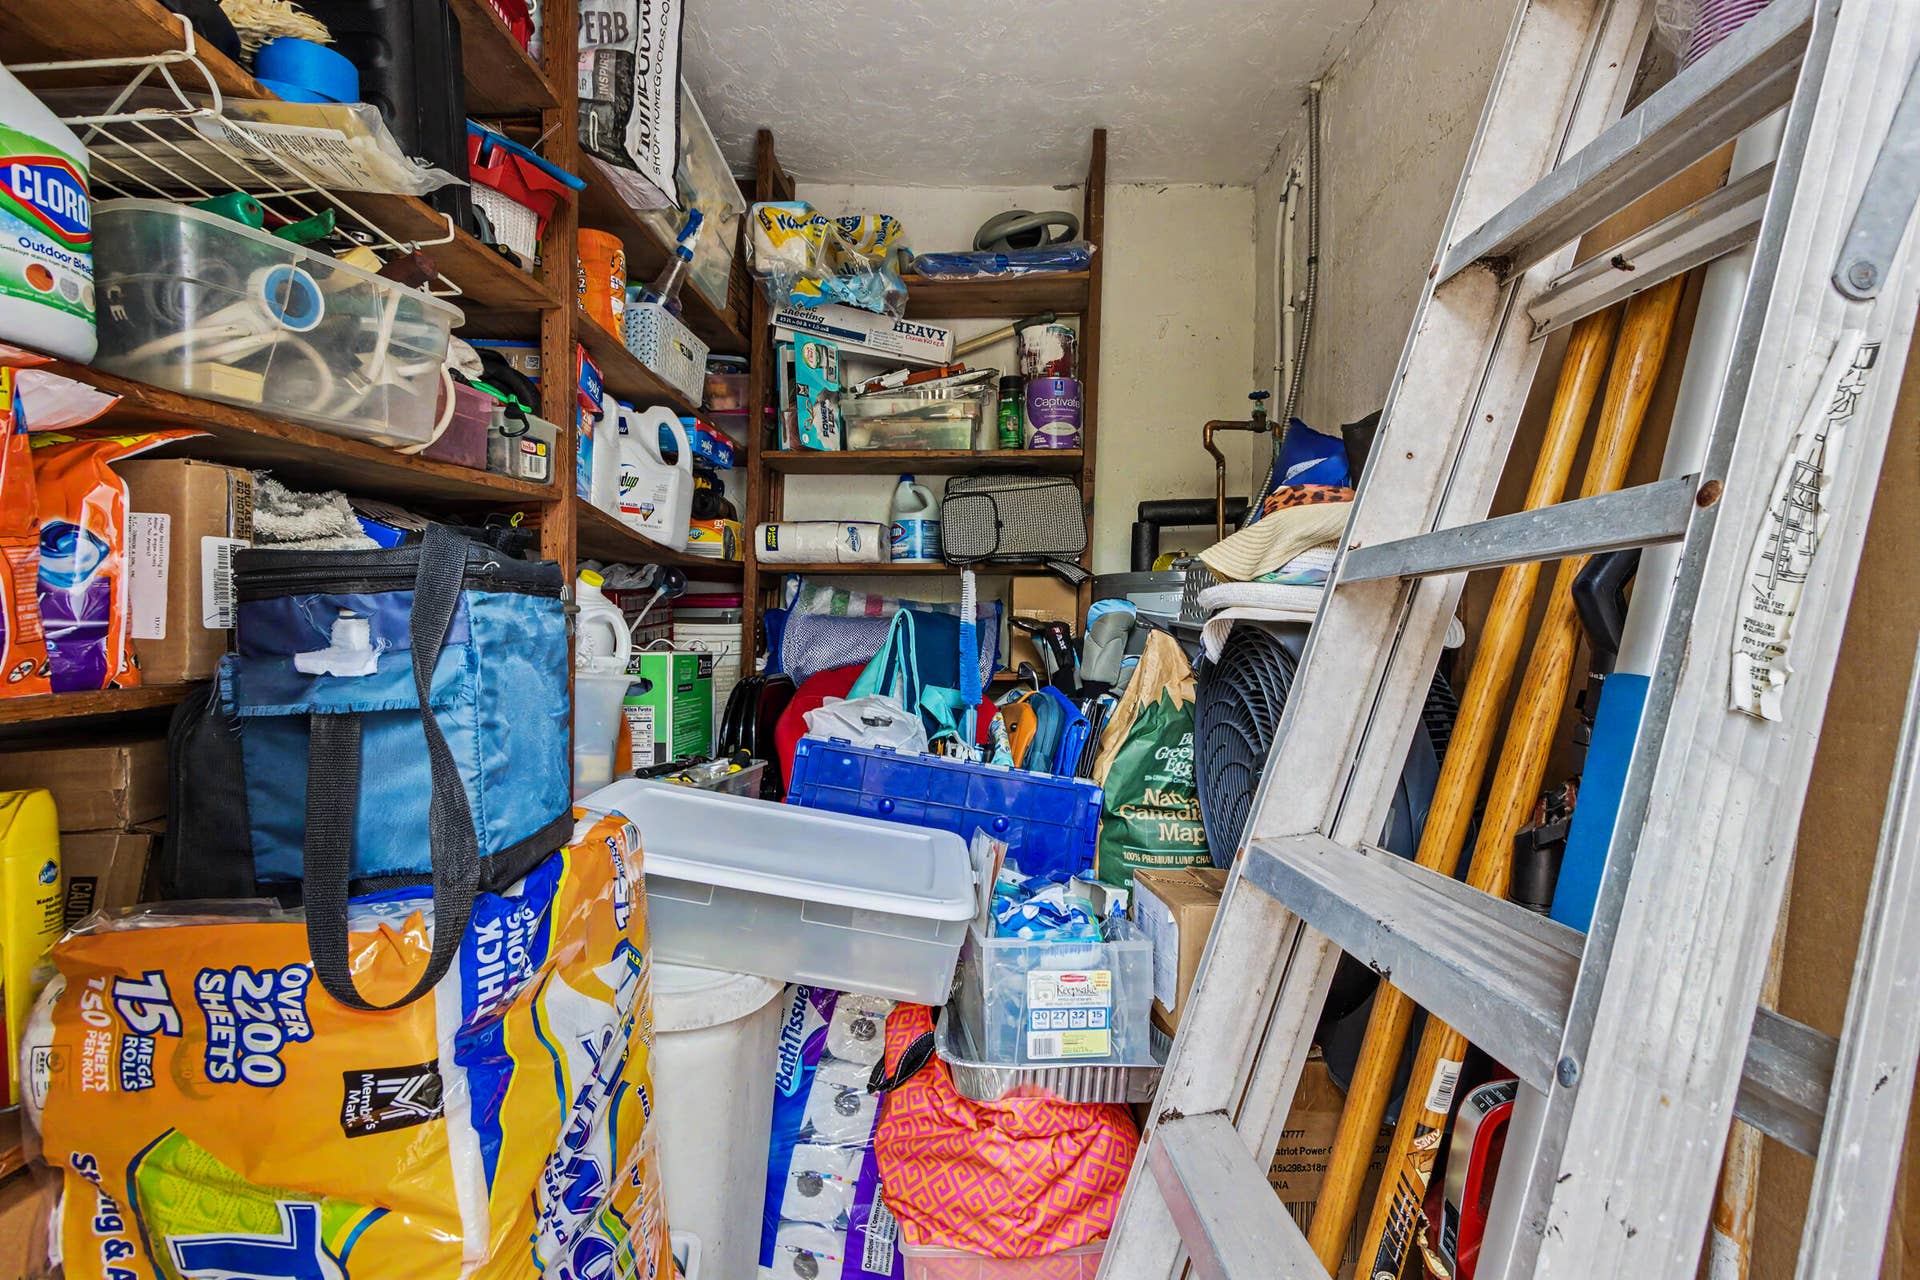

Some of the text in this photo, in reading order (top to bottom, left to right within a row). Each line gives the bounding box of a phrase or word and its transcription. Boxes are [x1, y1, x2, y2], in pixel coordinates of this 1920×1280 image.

[579, 10, 630, 44] ERB
[599, 53, 610, 97] INSPIRE
[11, 162, 92, 230] CLORO
[18, 237, 72, 264] Outdoor
[893, 320, 948, 341] HEAVY
[822, 399, 830, 438] POWER
[237, 480, 244, 495] DO
[244, 508, 251, 523] AS
[1179, 732, 1194, 747] Bi
[1119, 804, 1202, 822] Canadi
[1143, 787, 1201, 808] Nata
[1159, 822, 1206, 846] Map
[1123, 851, 1142, 862] 100%
[1142, 853, 1174, 865] PREMIUM
[1175, 854, 1195, 865] LUMP
[66, 882, 94, 930] CAUTI
[471, 916, 506, 1025] THICK
[80, 976, 113, 1028] 150
[114, 973, 181, 1037] 15
[278, 966, 311, 1038] OVER
[1034, 1010, 1103, 1020] 30 27 32 15
[199, 972, 237, 1080] SHEETS
[232, 969, 283, 1084] 2200
[81, 1029, 98, 1093] PER ROLL
[94, 1031, 112, 1093] SHEETS
[122, 1035, 139, 1091] ROLLS
[136, 1037, 154, 1089] MEGA
[1275, 1146, 1327, 1156] atriot Power
[1413, 1128, 1441, 1150] AMES
[1271, 1180, 1289, 1190] INA
[71, 1152, 124, 1234] Stng
[104, 1238, 135, 1261] &
